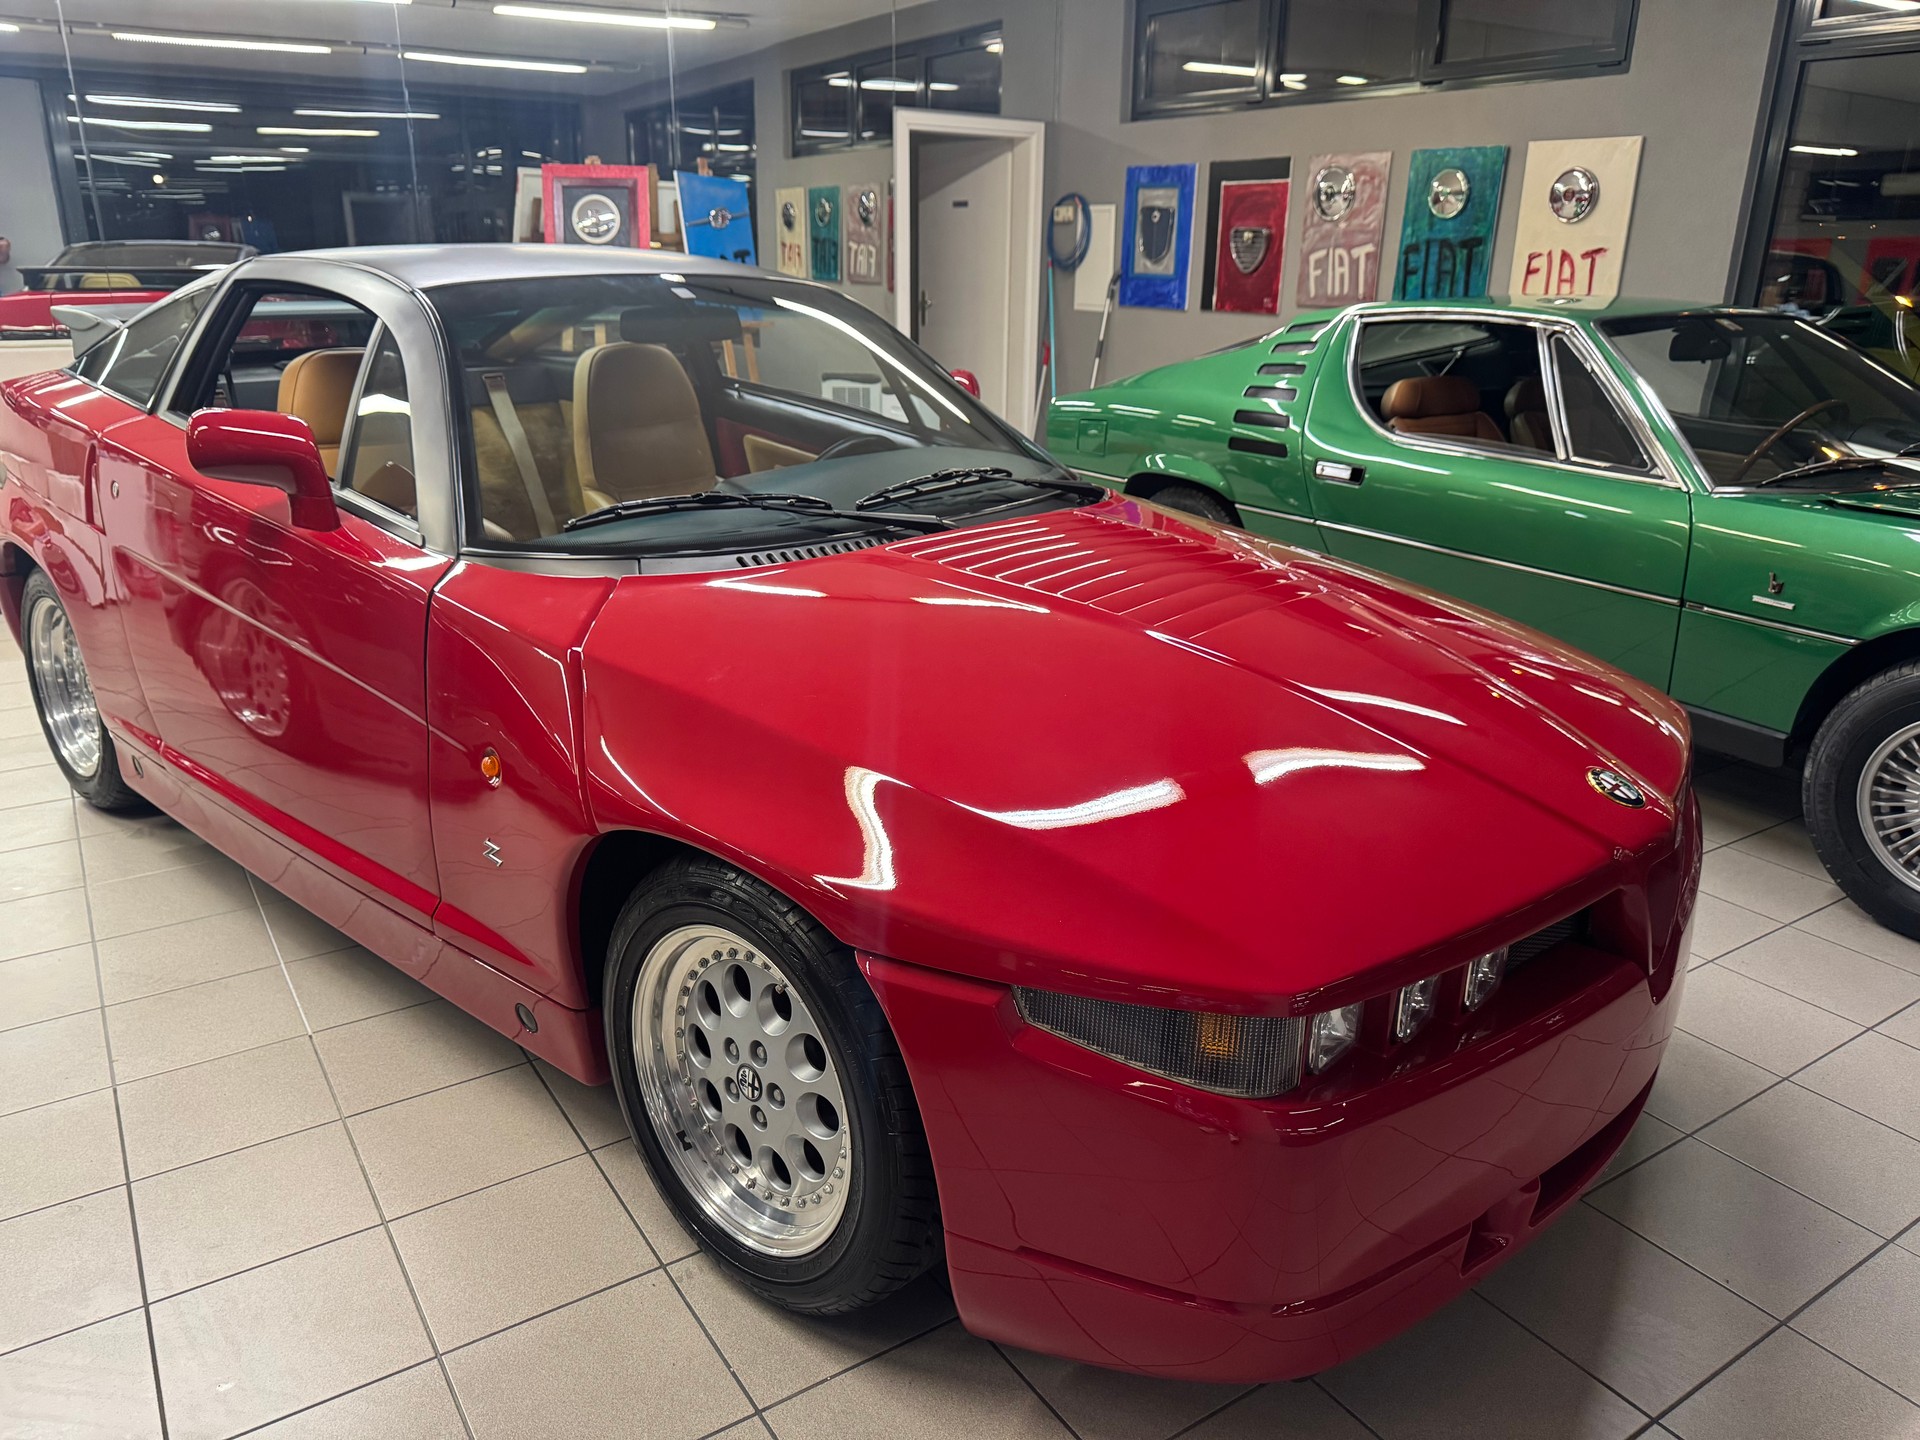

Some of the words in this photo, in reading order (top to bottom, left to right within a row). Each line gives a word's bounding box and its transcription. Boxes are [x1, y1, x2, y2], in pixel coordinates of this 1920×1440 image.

[1308, 243, 1377, 300] FIAT
[1402, 237, 1484, 300] FIAT
[1521, 247, 1609, 296] FIAT
